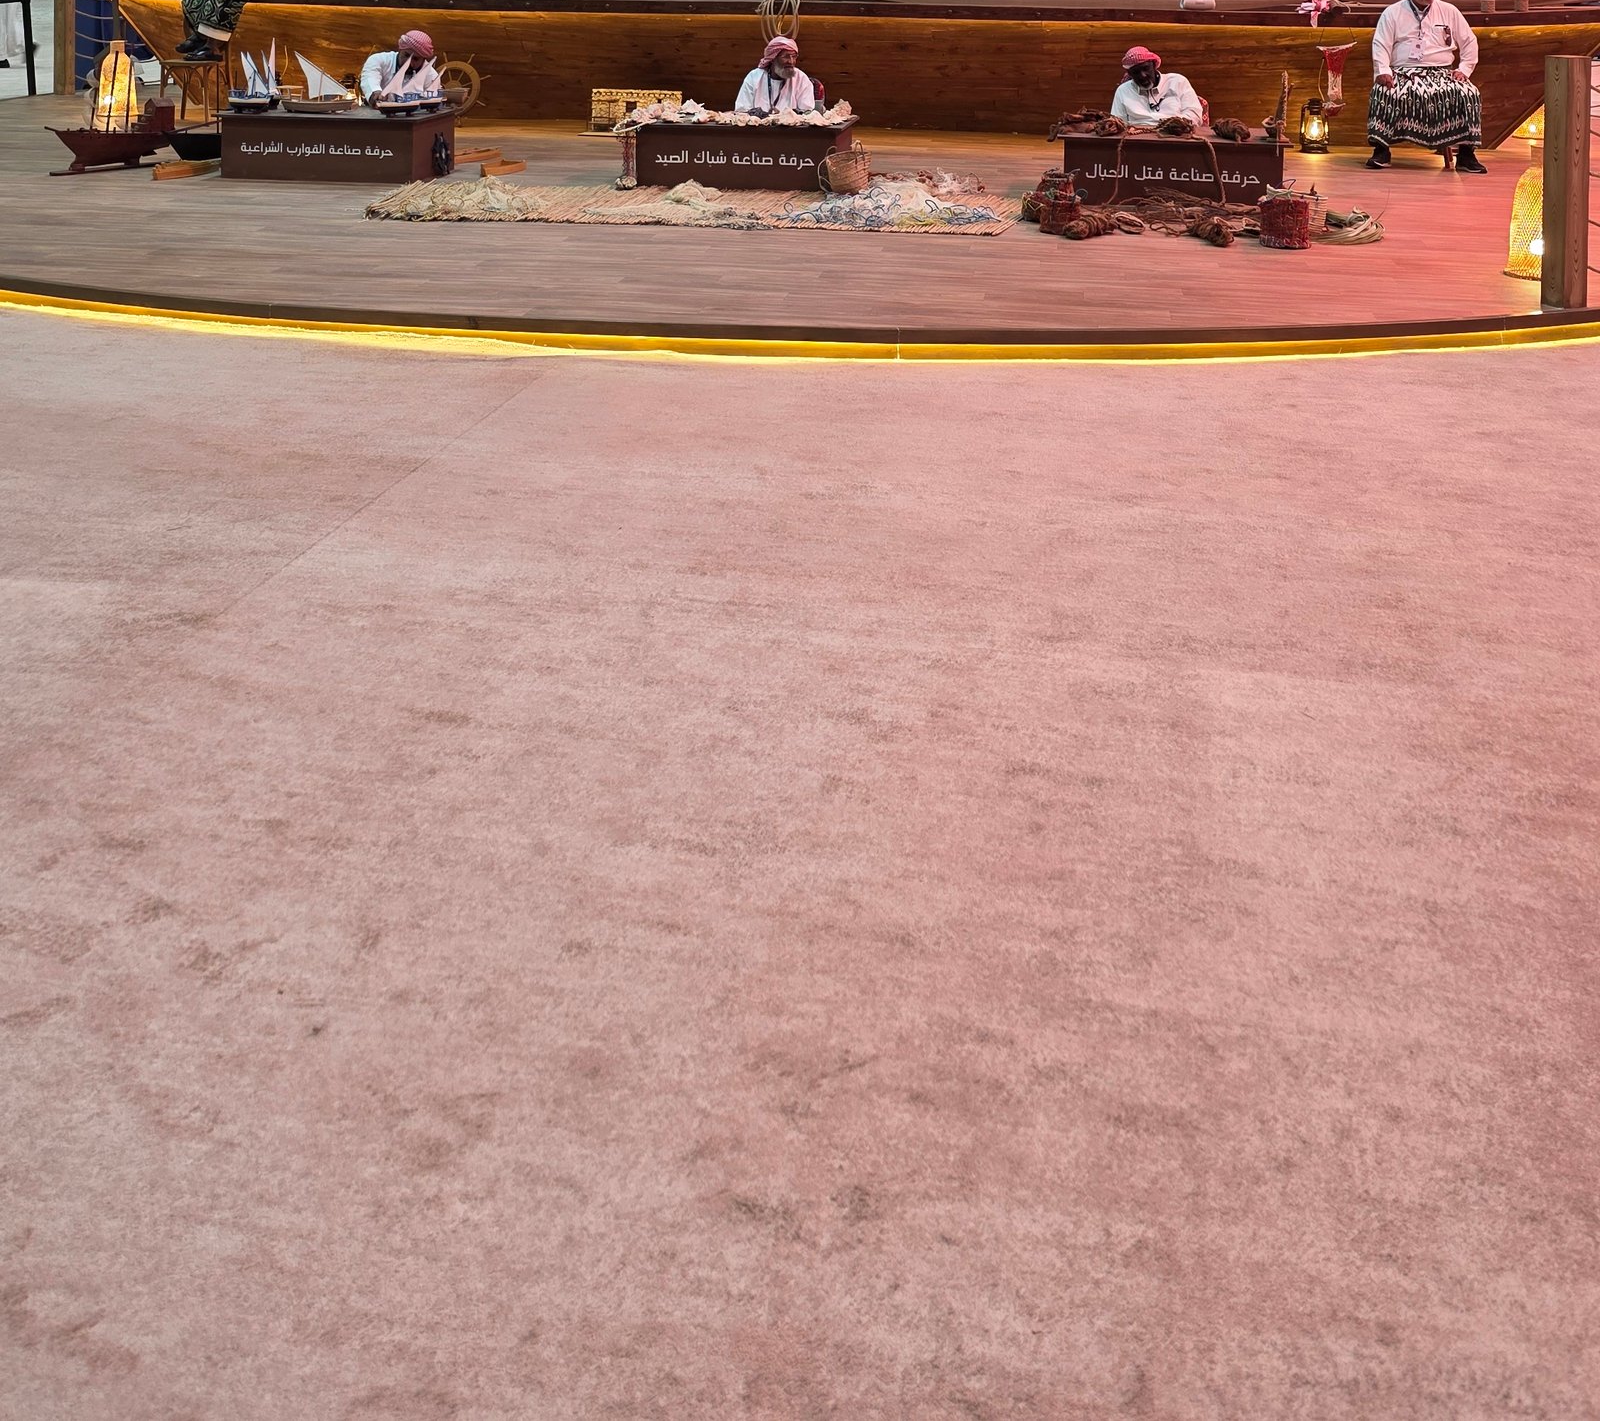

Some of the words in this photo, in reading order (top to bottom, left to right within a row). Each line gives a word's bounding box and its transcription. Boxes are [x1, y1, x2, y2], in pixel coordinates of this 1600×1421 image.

[240, 141, 283, 156] الشراعية
[286, 143, 326, 157] القوارب
[329, 144, 361, 156] صناعة
[365, 145, 394, 159] حرفة
[655, 150, 689, 167] الصيد
[694, 150, 727, 167] شباك
[732, 151, 773, 165] صناعة
[779, 153, 815, 170] حرفة
[1085, 163, 1129, 179] الحبال
[1134, 165, 1164, 180] فتل
[1169, 167, 1215, 182] صناعة
[1220, 169, 1260, 188] حرفة
